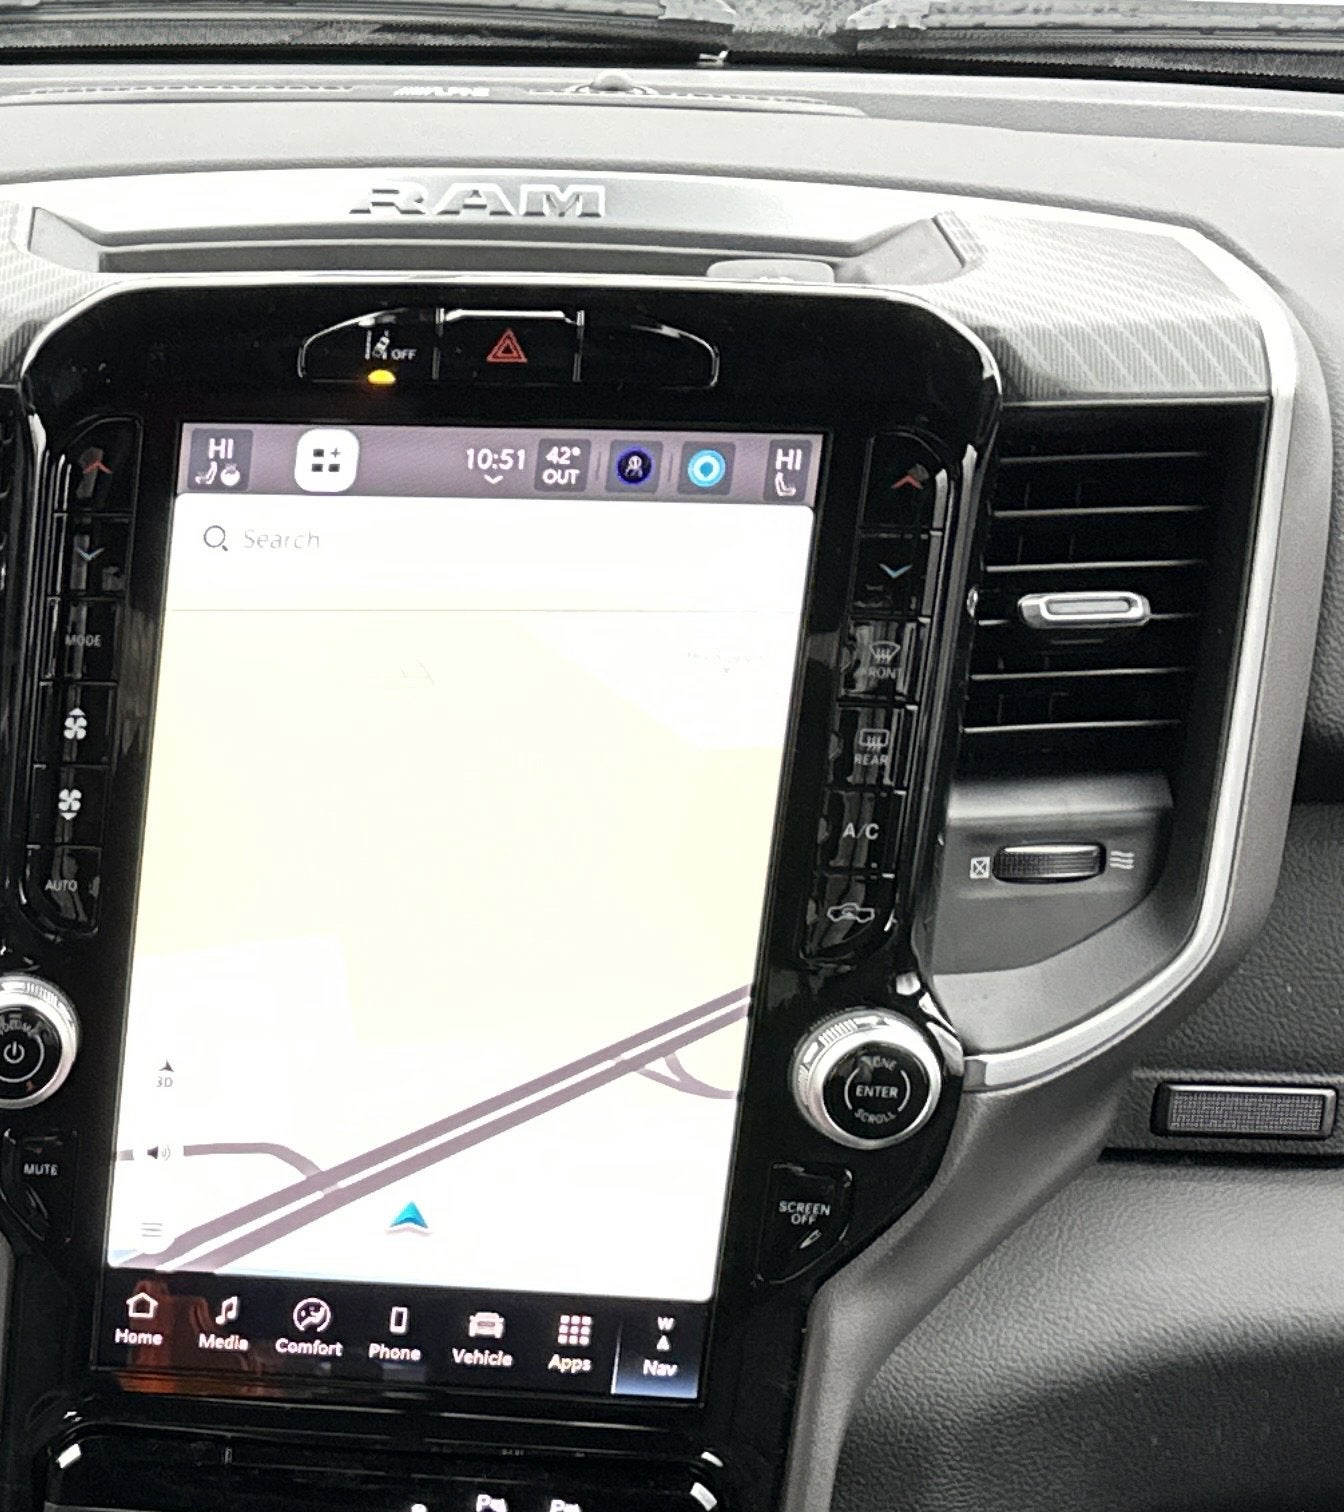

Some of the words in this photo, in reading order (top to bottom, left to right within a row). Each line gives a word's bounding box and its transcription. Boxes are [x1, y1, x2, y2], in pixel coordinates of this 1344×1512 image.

[349, 181, 606, 218] RAM
[391, 349, 416, 361] OFF
[208, 438, 234, 459] HI
[466, 448, 526, 472] 10:51
[775, 449, 803, 471] HI
[542, 469, 580, 485] OUT
[243, 528, 321, 550] Search
[65, 634, 102, 648] MODE
[854, 753, 890, 767] REAR
[843, 823, 880, 841] A/C
[45, 878, 79, 893] AUTO
[156, 1076, 174, 1089] 3D
[855, 1084, 899, 1099] ENTER
[854, 1107, 897, 1125] SCROLL
[23, 1162, 59, 1177] MUTE
[778, 1200, 832, 1217] SCREEN
[790, 1213, 817, 1226] OFF
[658, 1317, 676, 1331] W
[114, 1327, 164, 1346] Home
[198, 1332, 250, 1351] Media
[275, 1337, 344, 1357] Comfort
[368, 1343, 422, 1362] Phone
[452, 1347, 514, 1367] Vehicle
[548, 1353, 593, 1374] Apps
[642, 1359, 679, 1378] Nav
